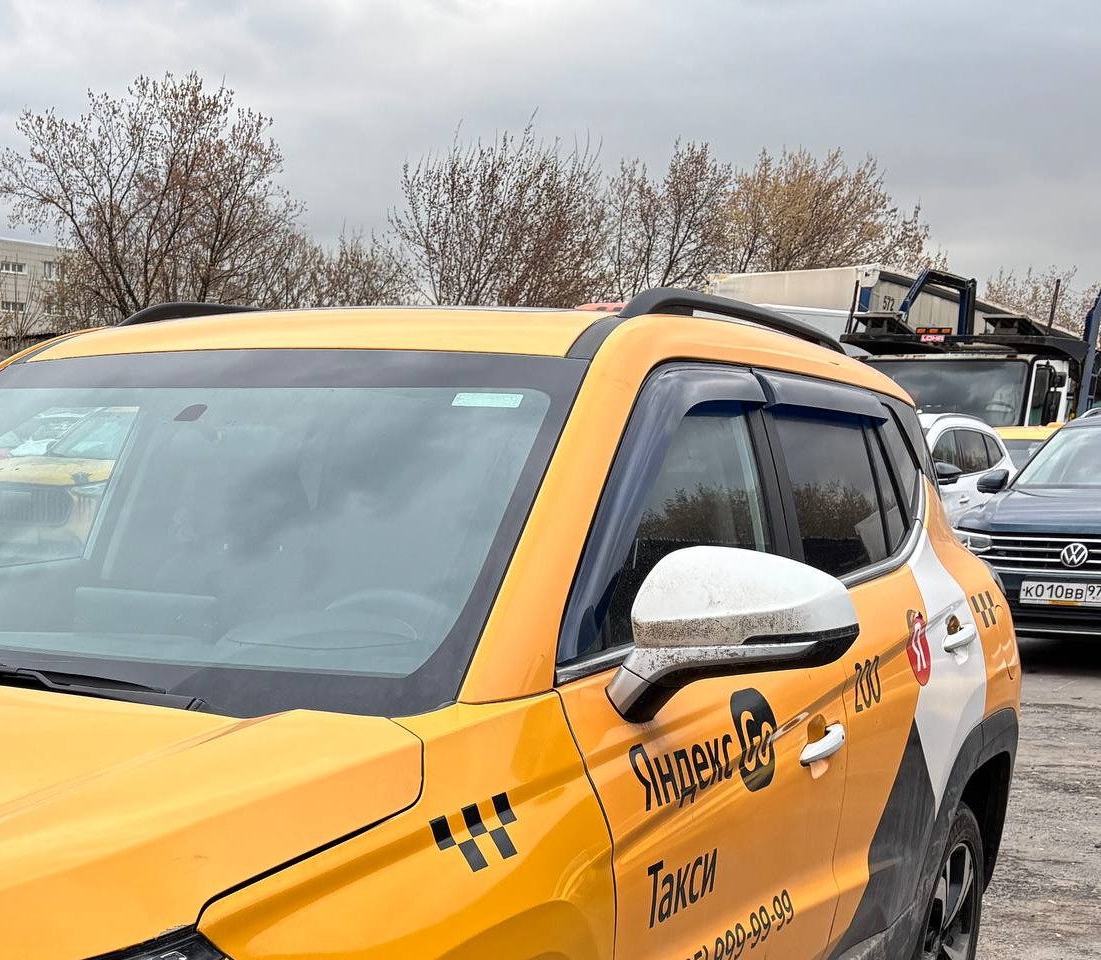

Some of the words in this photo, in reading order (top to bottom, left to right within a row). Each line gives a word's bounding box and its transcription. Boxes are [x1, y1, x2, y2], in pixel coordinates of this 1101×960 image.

[882, 295, 896, 312] 572
[854, 655, 881, 713] 200
[629, 734, 733, 811] Яндекс
[741, 711, 774, 772] Go
[647, 848, 718, 929] Такси
